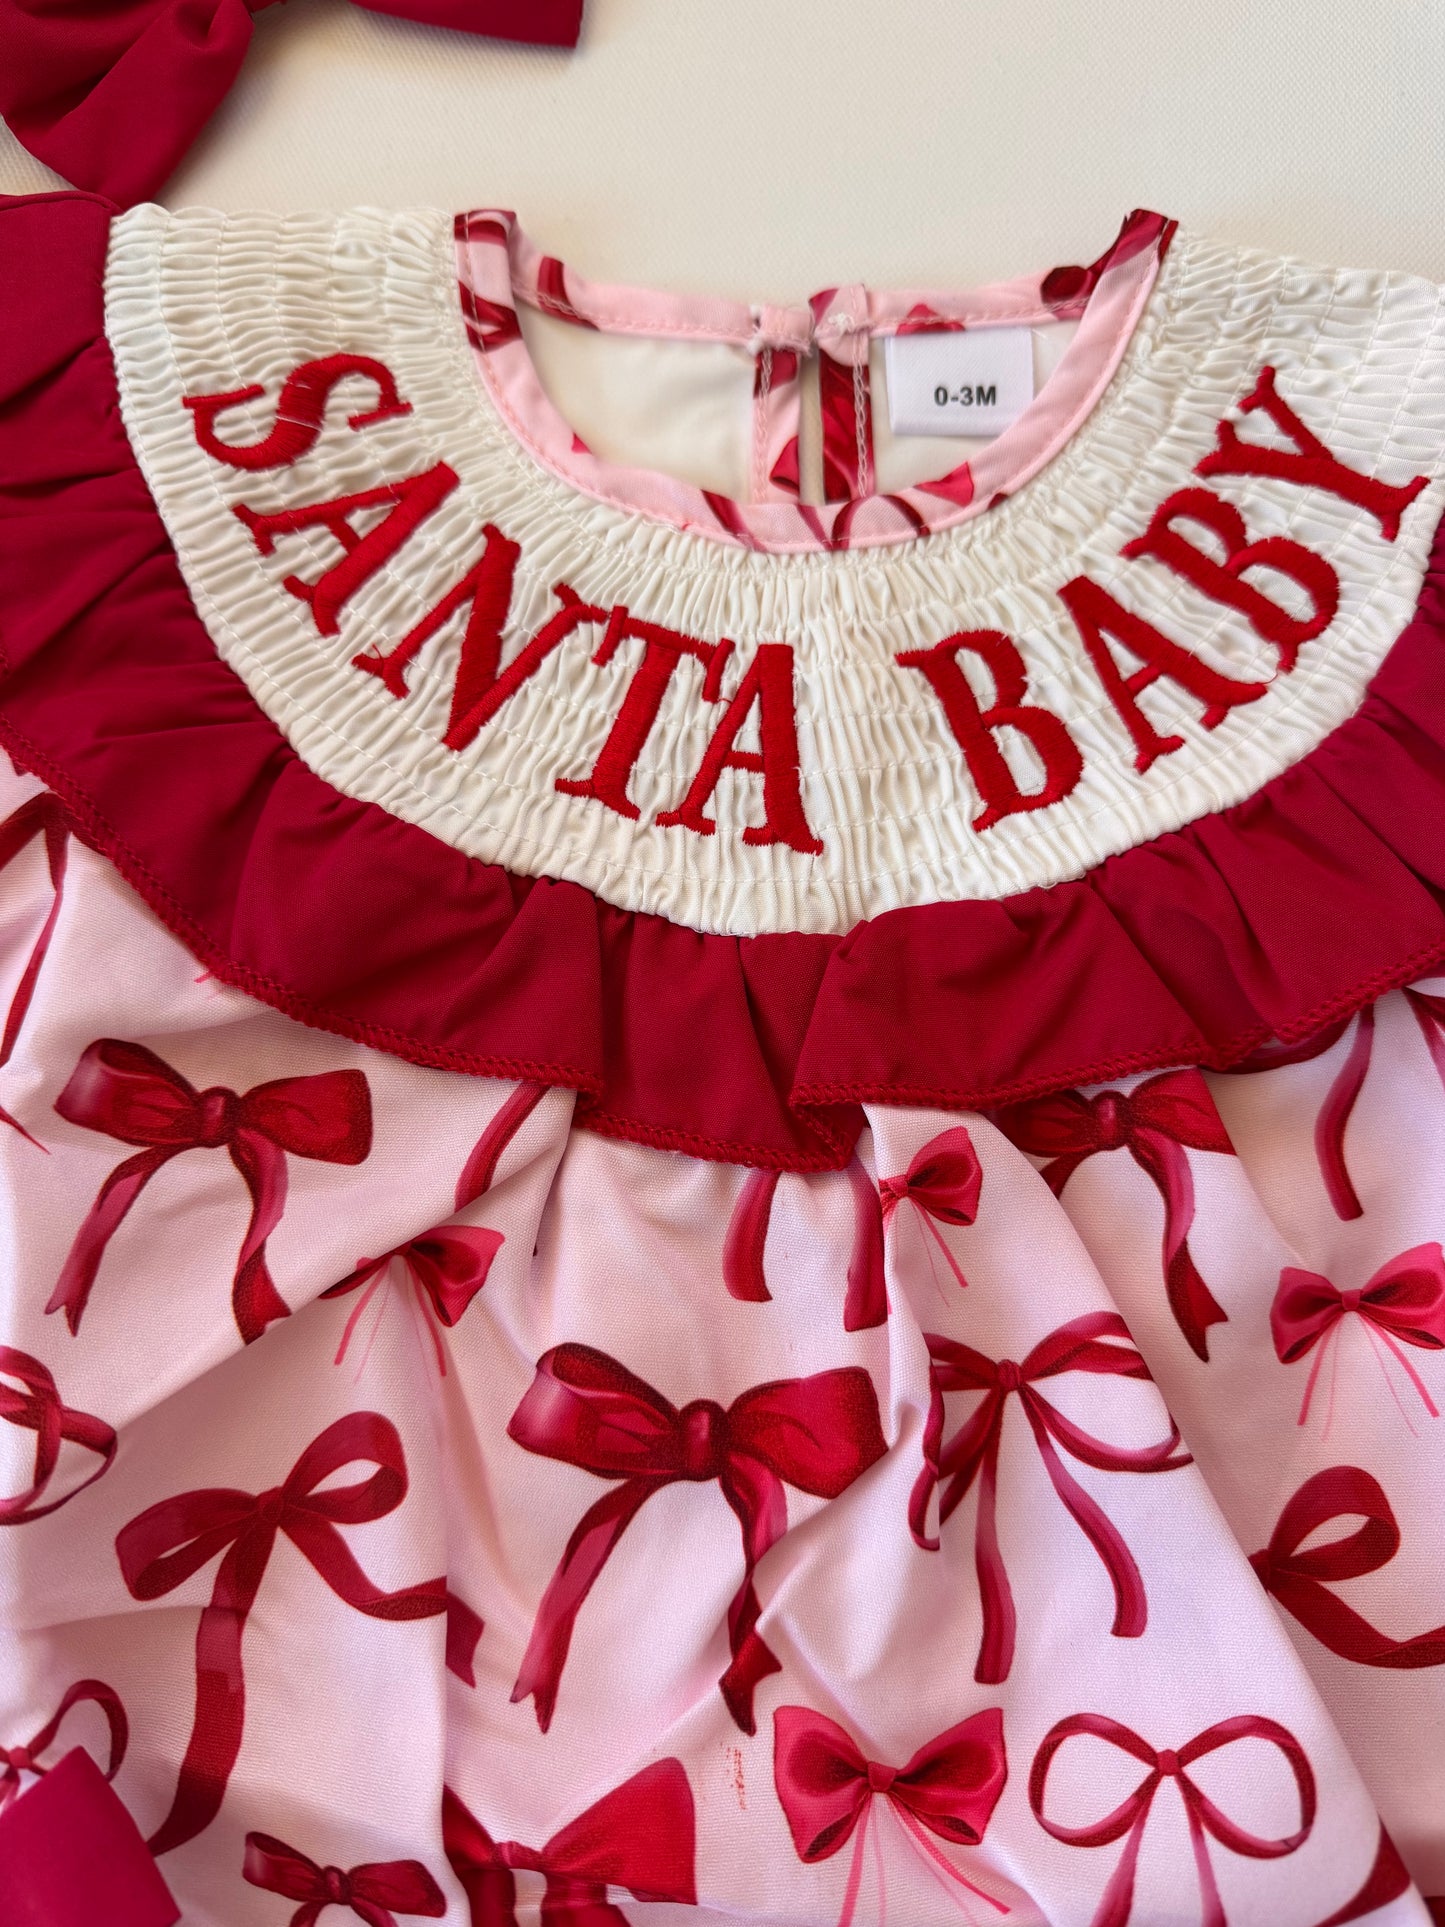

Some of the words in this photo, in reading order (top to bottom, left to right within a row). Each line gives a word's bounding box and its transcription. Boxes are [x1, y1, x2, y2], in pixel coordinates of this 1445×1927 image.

[934, 385, 997, 406] 0-3M
[181, 352, 824, 857] SANTA
[895, 366, 1432, 833] BABY
